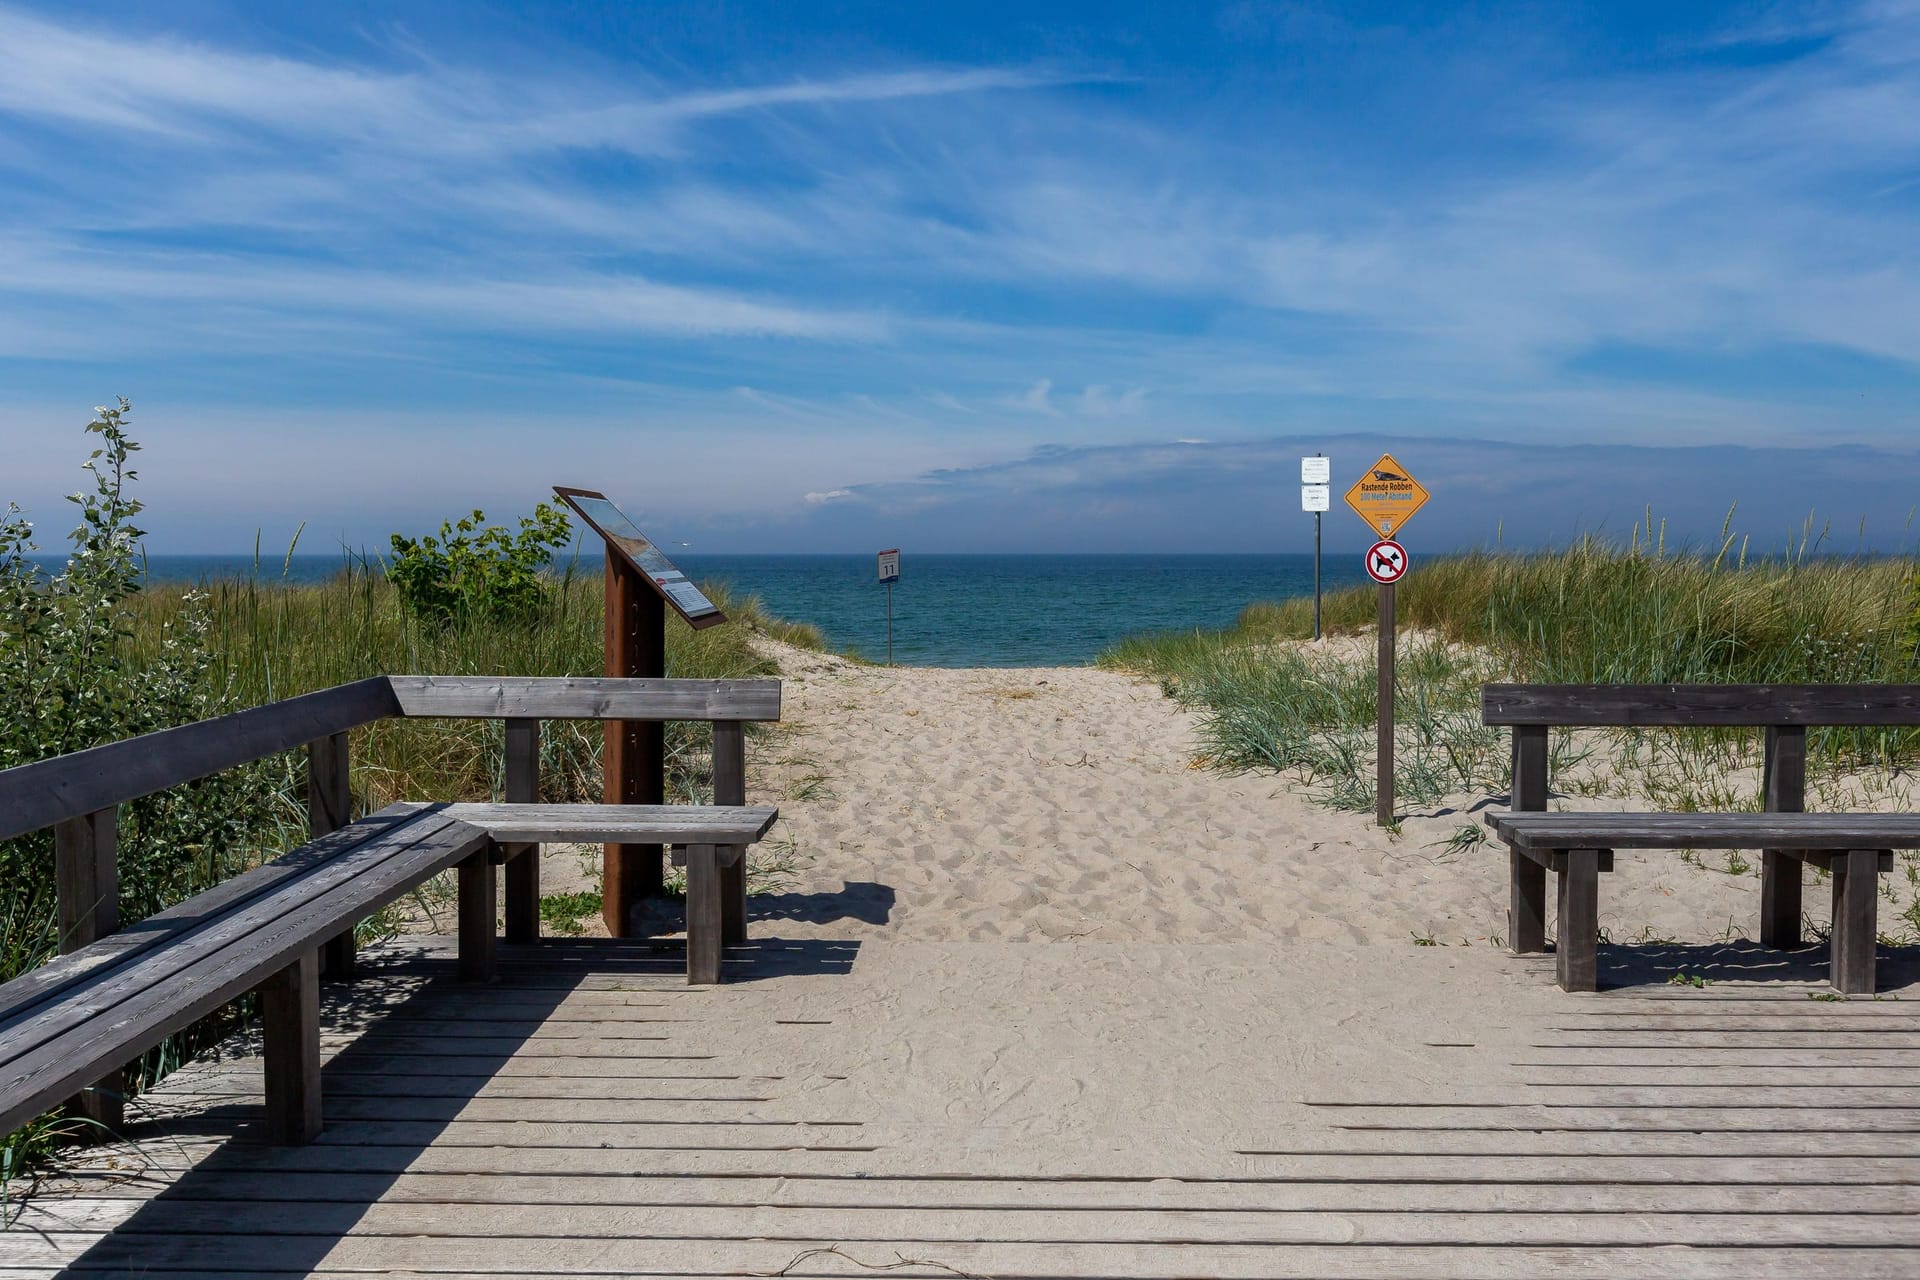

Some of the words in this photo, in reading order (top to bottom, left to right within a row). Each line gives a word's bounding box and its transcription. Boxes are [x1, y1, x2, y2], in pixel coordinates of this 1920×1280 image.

[1361, 482, 1388, 491] Rastende
[1389, 482, 1412, 491] Robben
[884, 564, 894, 576] 11
